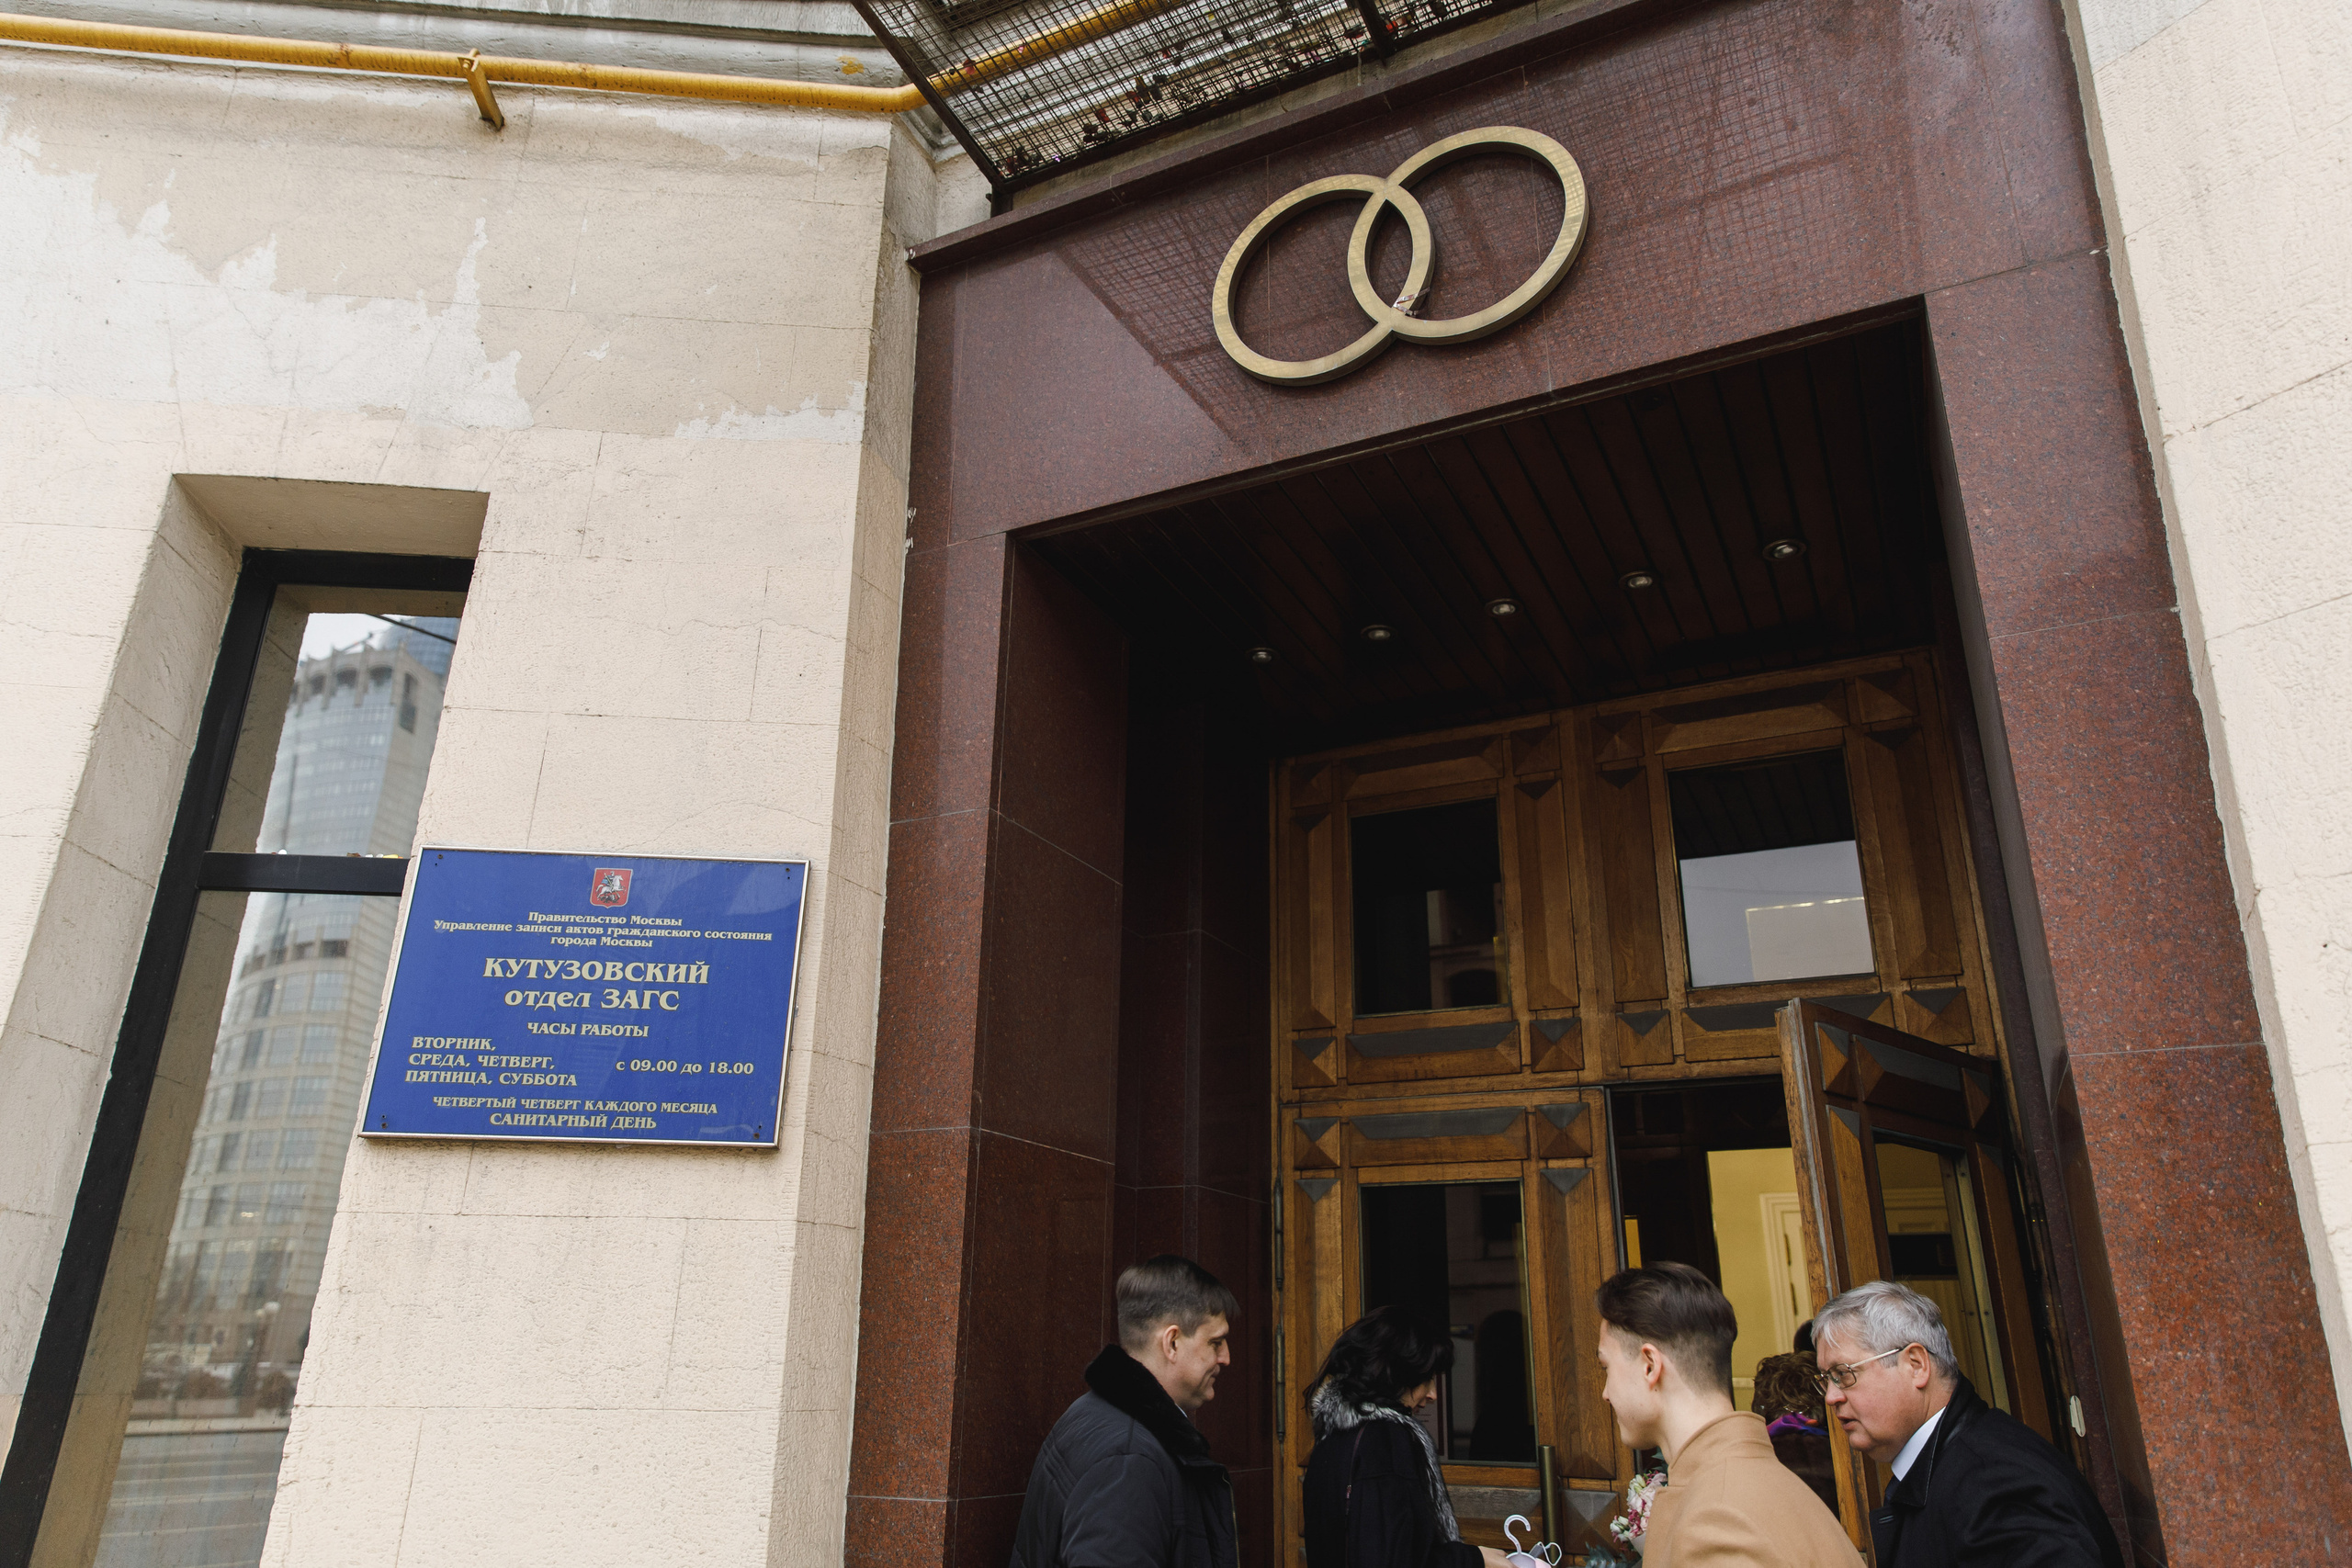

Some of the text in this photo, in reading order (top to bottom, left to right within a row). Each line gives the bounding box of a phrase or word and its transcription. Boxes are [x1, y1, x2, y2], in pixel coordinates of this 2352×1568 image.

[527, 911, 683, 926] Правительство Москвы
[434, 920, 772, 941] Управление записи актов гражданского состояния
[549, 936, 652, 948] города Москвы
[482, 957, 709, 985] КУТУЗОВСКИЙ
[503, 988, 679, 1011] отдел ЗАГС
[526, 1022, 649, 1038] ЧАСЫ РАБОТЫ
[411, 1036, 495, 1052] ВТОРНИК,
[408, 1054, 554, 1070] СРЕДА, ЧЕТВЕРГ,
[616, 1059, 754, 1075] с 09.00 до 18.00
[404, 1070, 577, 1087] ПЯТНИЦА, СУББОТА
[432, 1096, 718, 1115] ЧЕТВЕРТЫЙ ЧЕТВЕРГ КАЖДОГО МЕСЯЦА
[489, 1112, 657, 1130] САНИТАРНЫЙ ДЕНЬ
